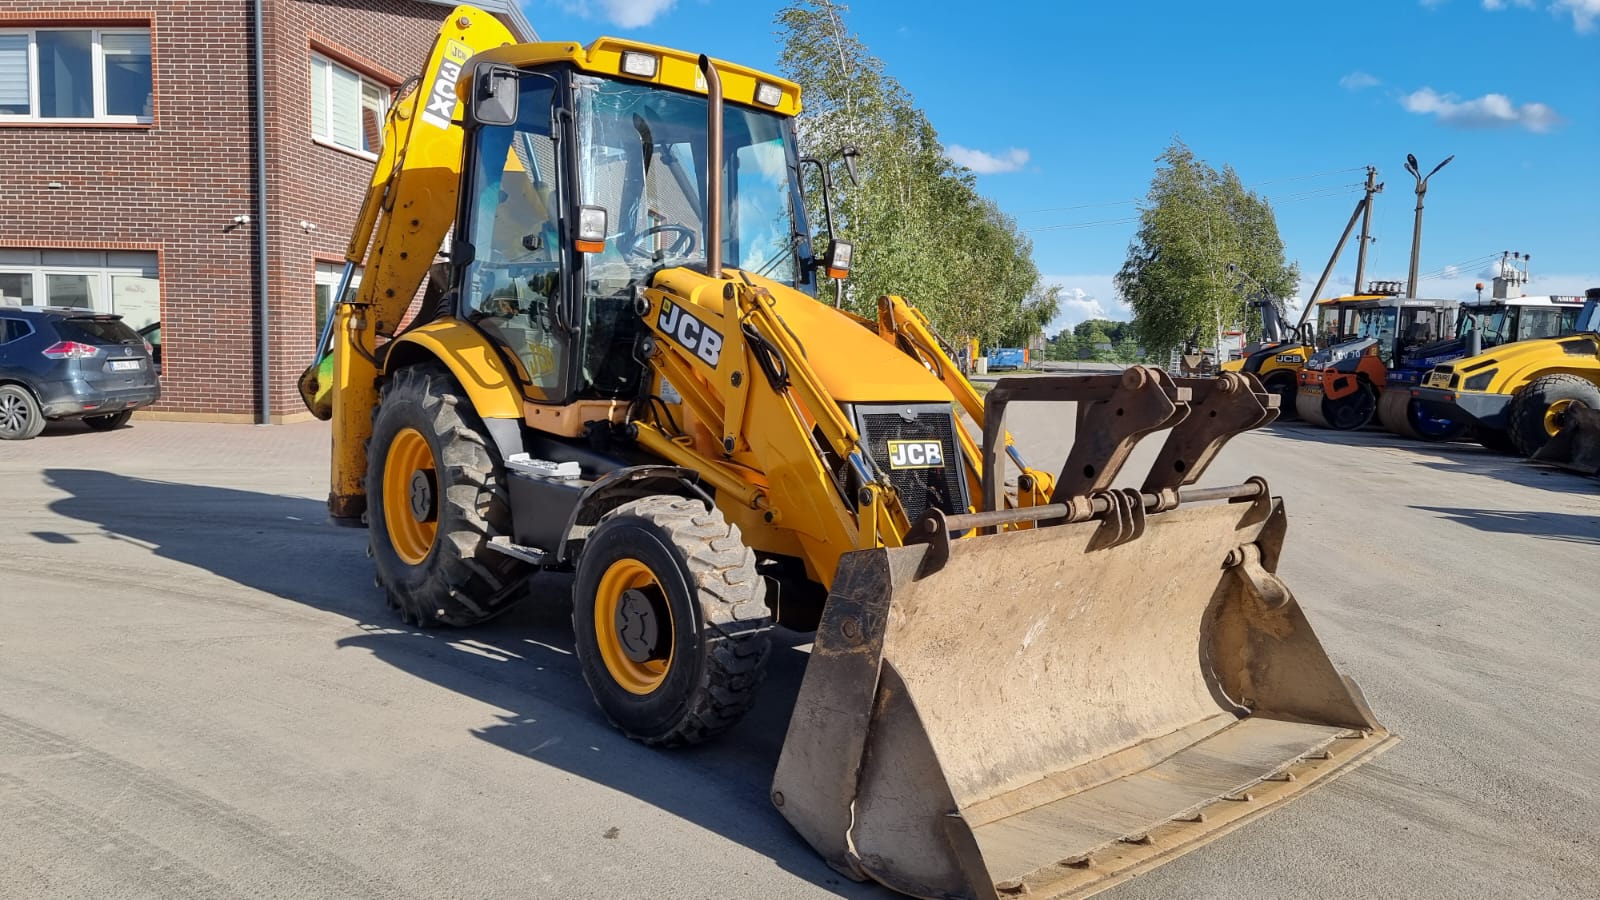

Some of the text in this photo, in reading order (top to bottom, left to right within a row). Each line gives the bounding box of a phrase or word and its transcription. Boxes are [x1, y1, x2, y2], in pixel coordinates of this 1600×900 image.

[450, 45, 468, 60] JCB
[660, 304, 722, 366] JCB
[1276, 355, 1301, 363] JCB
[1351, 350, 1361, 358] 70
[892, 443, 941, 465] JCB
